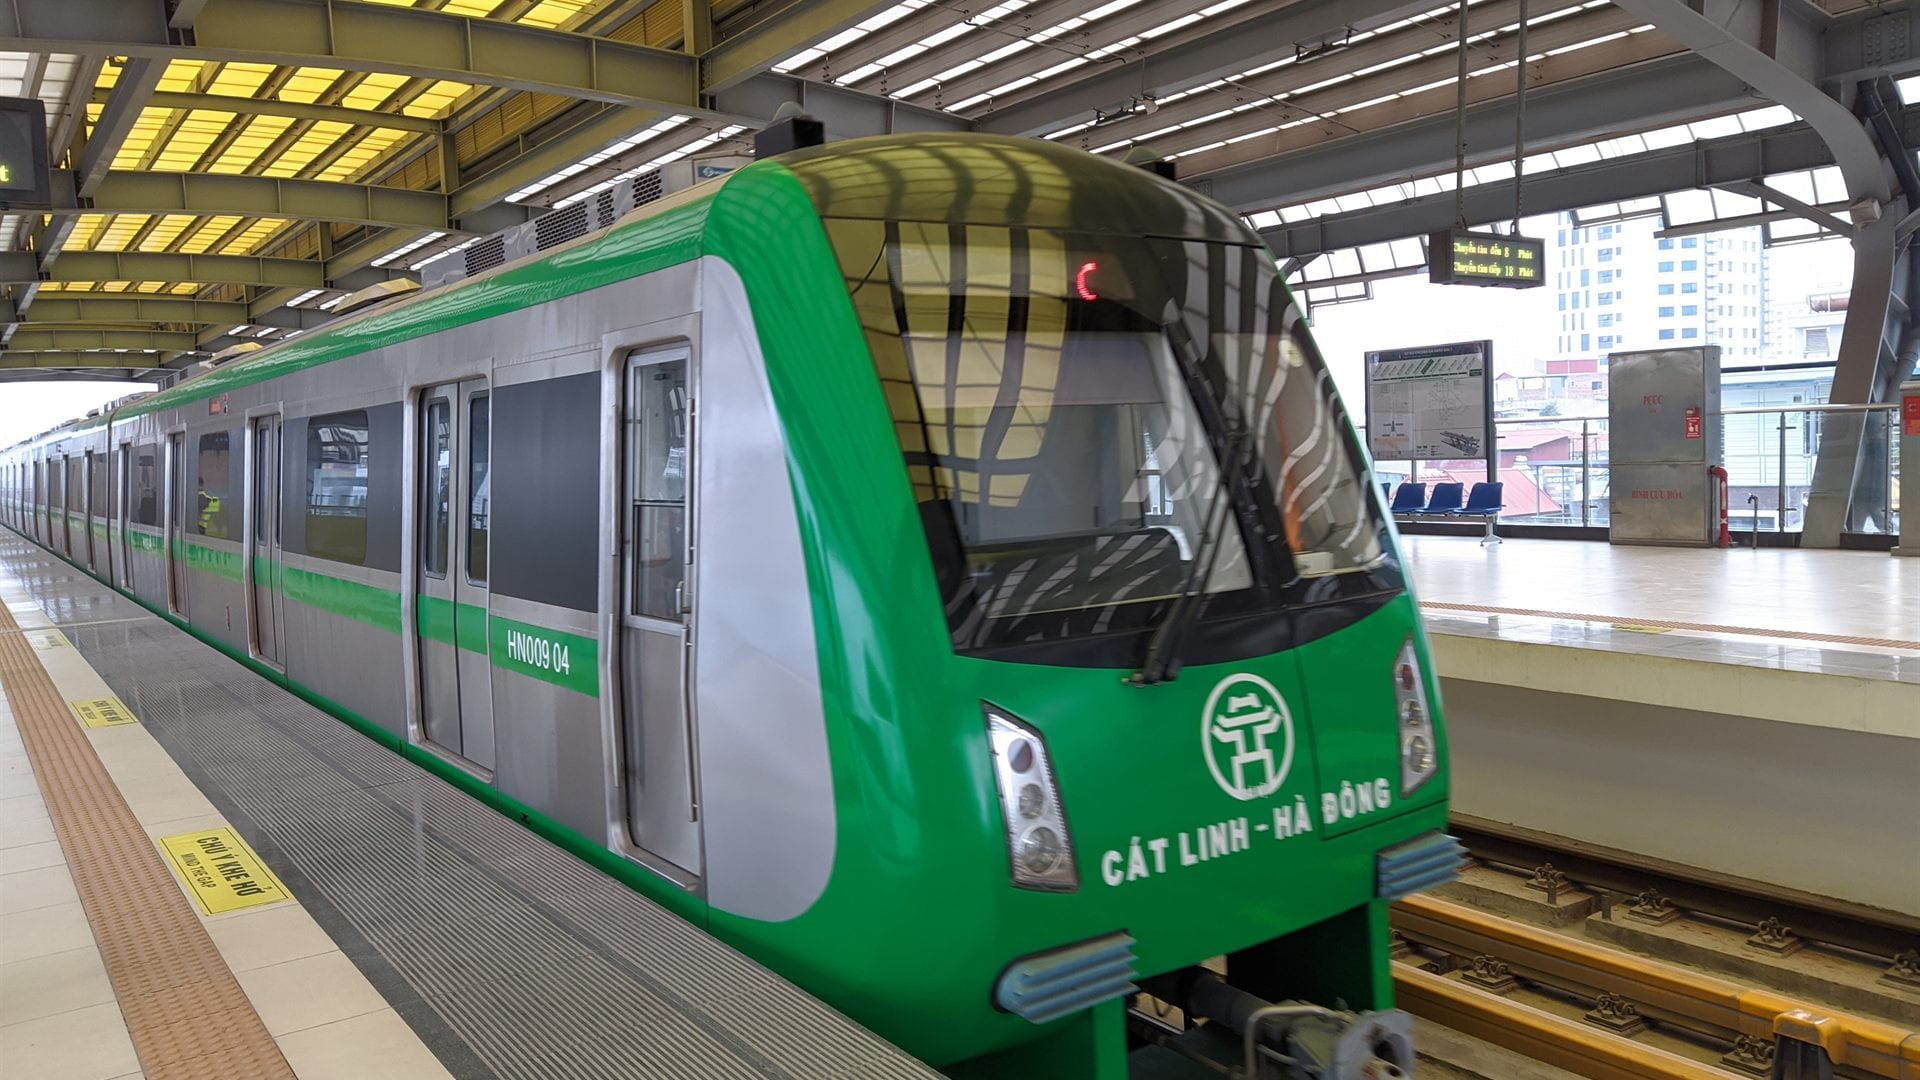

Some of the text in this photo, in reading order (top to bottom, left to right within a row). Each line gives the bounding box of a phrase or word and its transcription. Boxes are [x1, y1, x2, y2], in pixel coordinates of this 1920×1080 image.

[507, 629, 570, 675] HN009 04
[1101, 836, 1169, 887] CÁT
[1178, 817, 1250, 867] LINH
[1272, 794, 1313, 840] HÀ
[1321, 777, 1392, 825] ĐÔNG
[180, 852, 217, 889] MIND THE GAP
[196, 836, 273, 897] CHÚ Ý KHE HỞ
